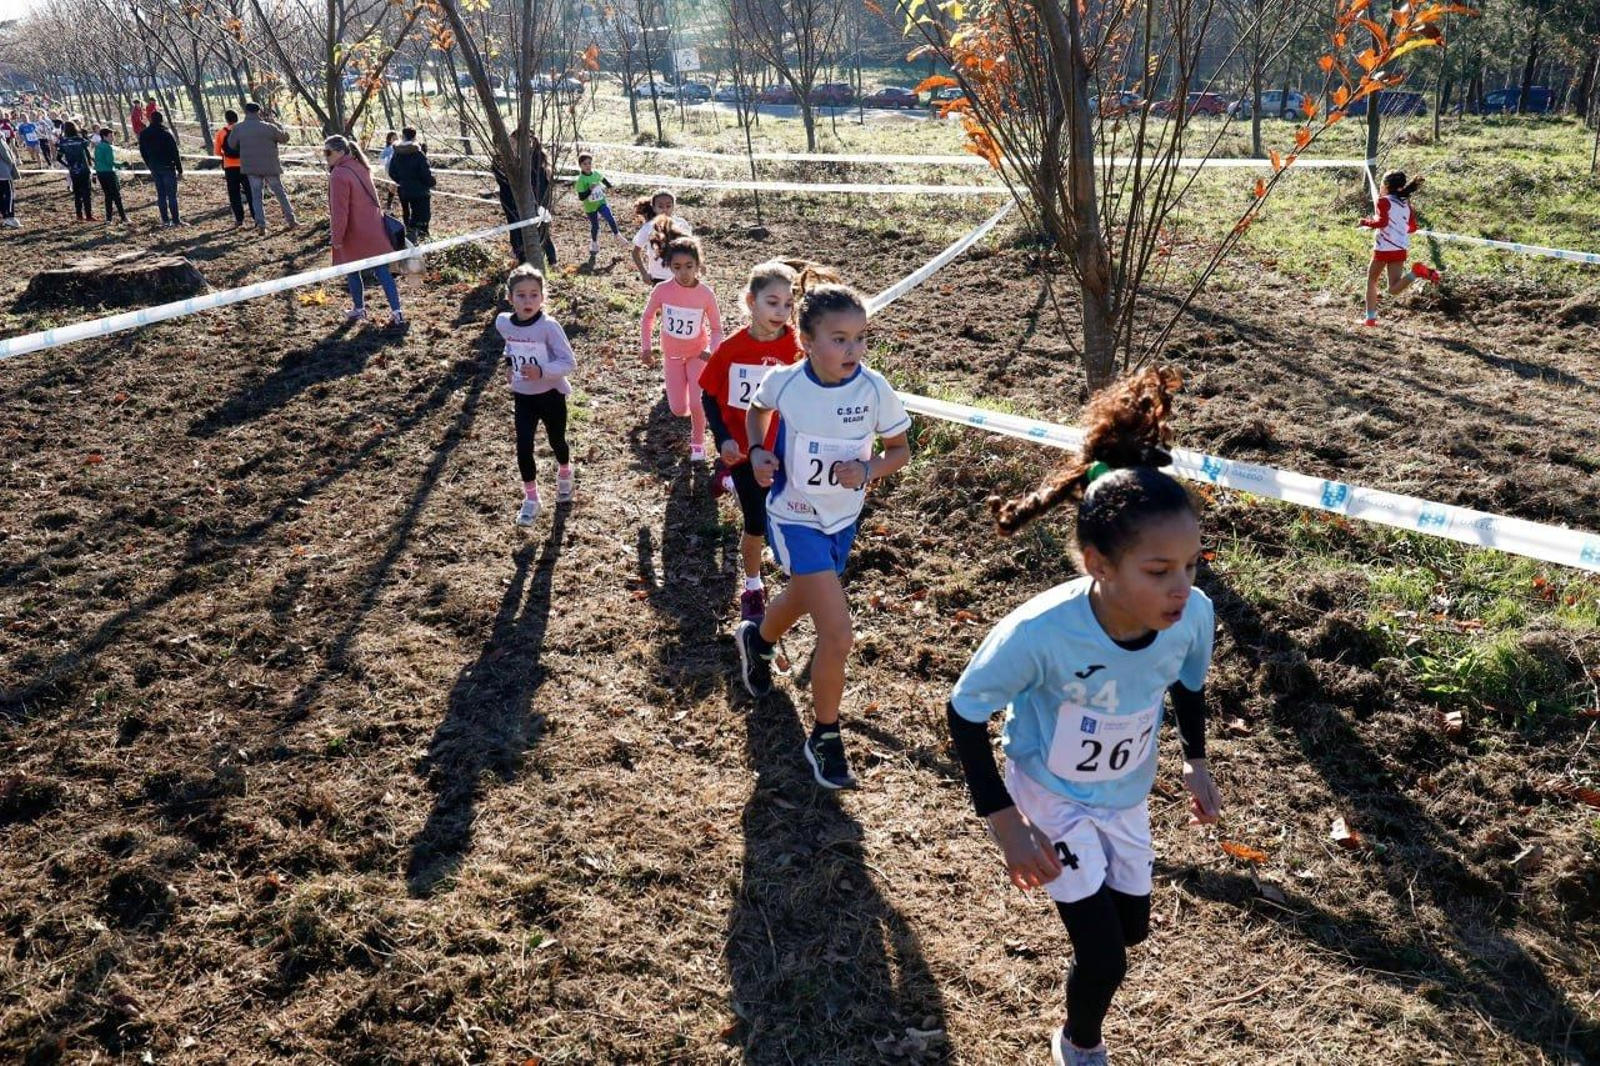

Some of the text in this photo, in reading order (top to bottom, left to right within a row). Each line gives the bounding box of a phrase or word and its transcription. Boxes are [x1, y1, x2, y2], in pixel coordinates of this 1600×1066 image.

[668, 316, 694, 336] 325
[1062, 680, 1120, 714] 34
[1076, 725, 1153, 772] 267
